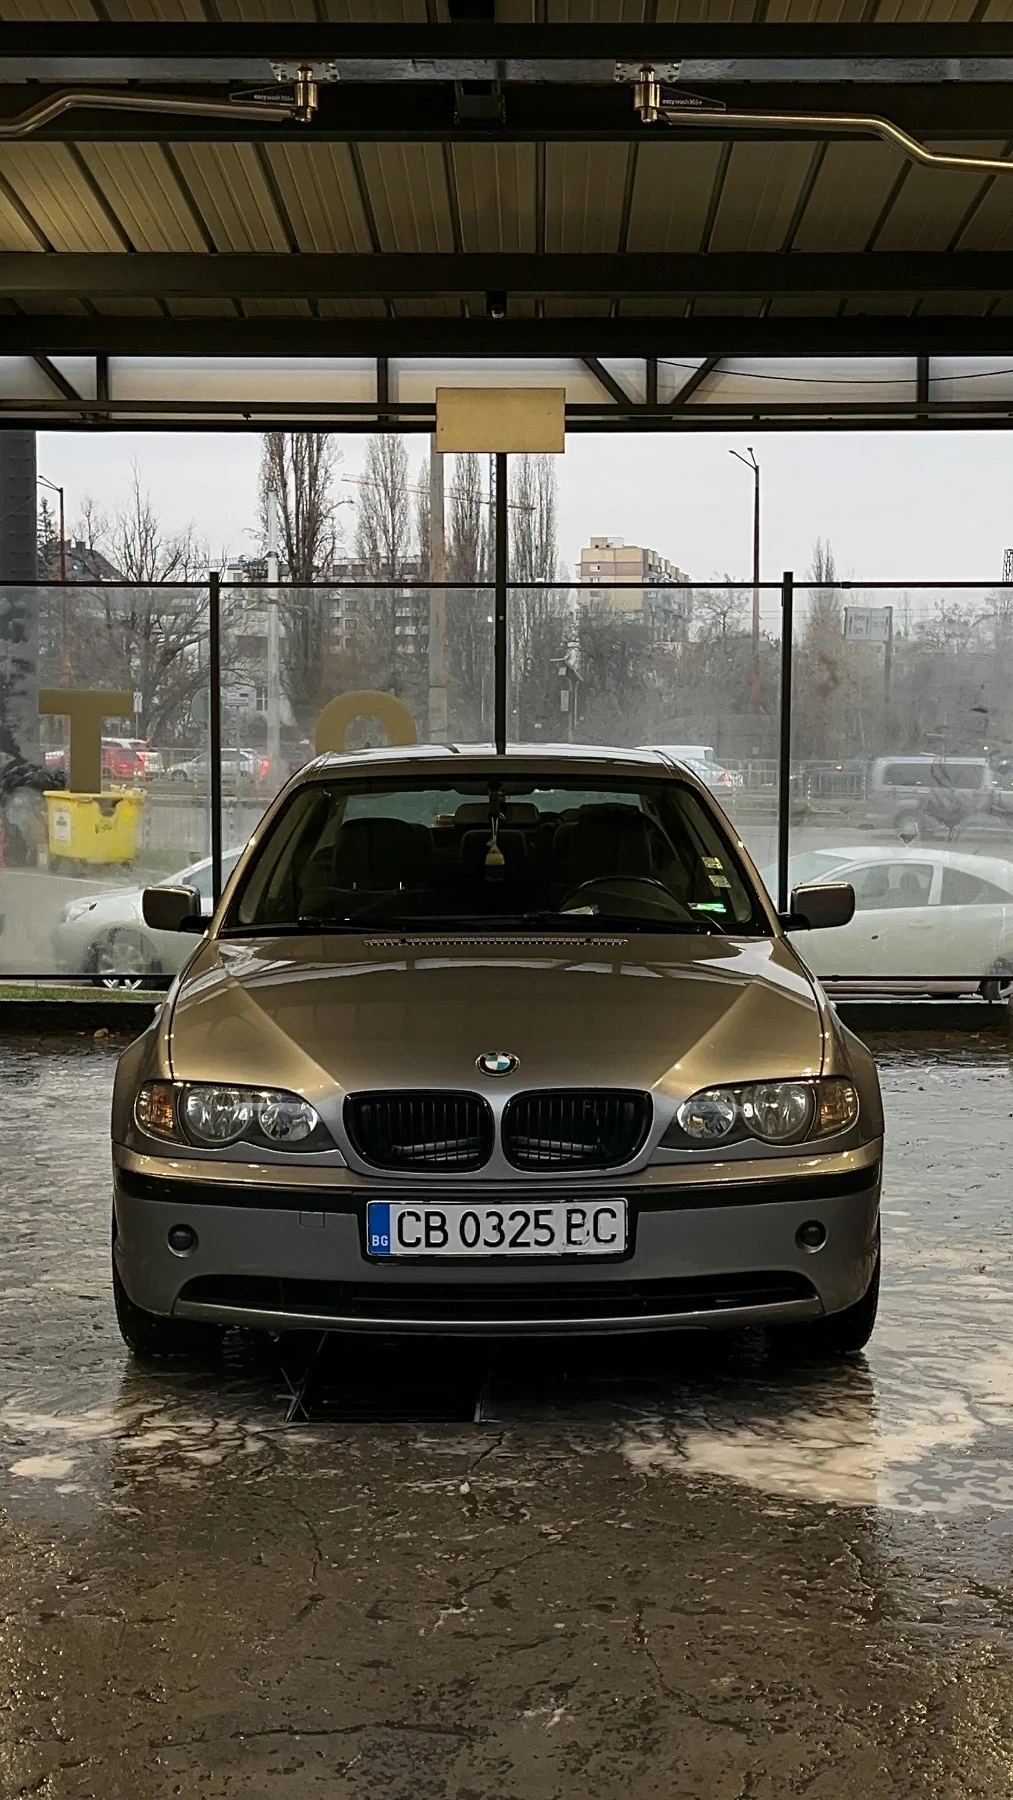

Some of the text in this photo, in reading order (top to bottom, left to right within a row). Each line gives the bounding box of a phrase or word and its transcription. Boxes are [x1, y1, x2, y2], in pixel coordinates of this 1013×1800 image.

[371, 1235, 389, 1247] BG
[397, 1210, 449, 1248] CB
[459, 1208, 556, 1248] 0325
